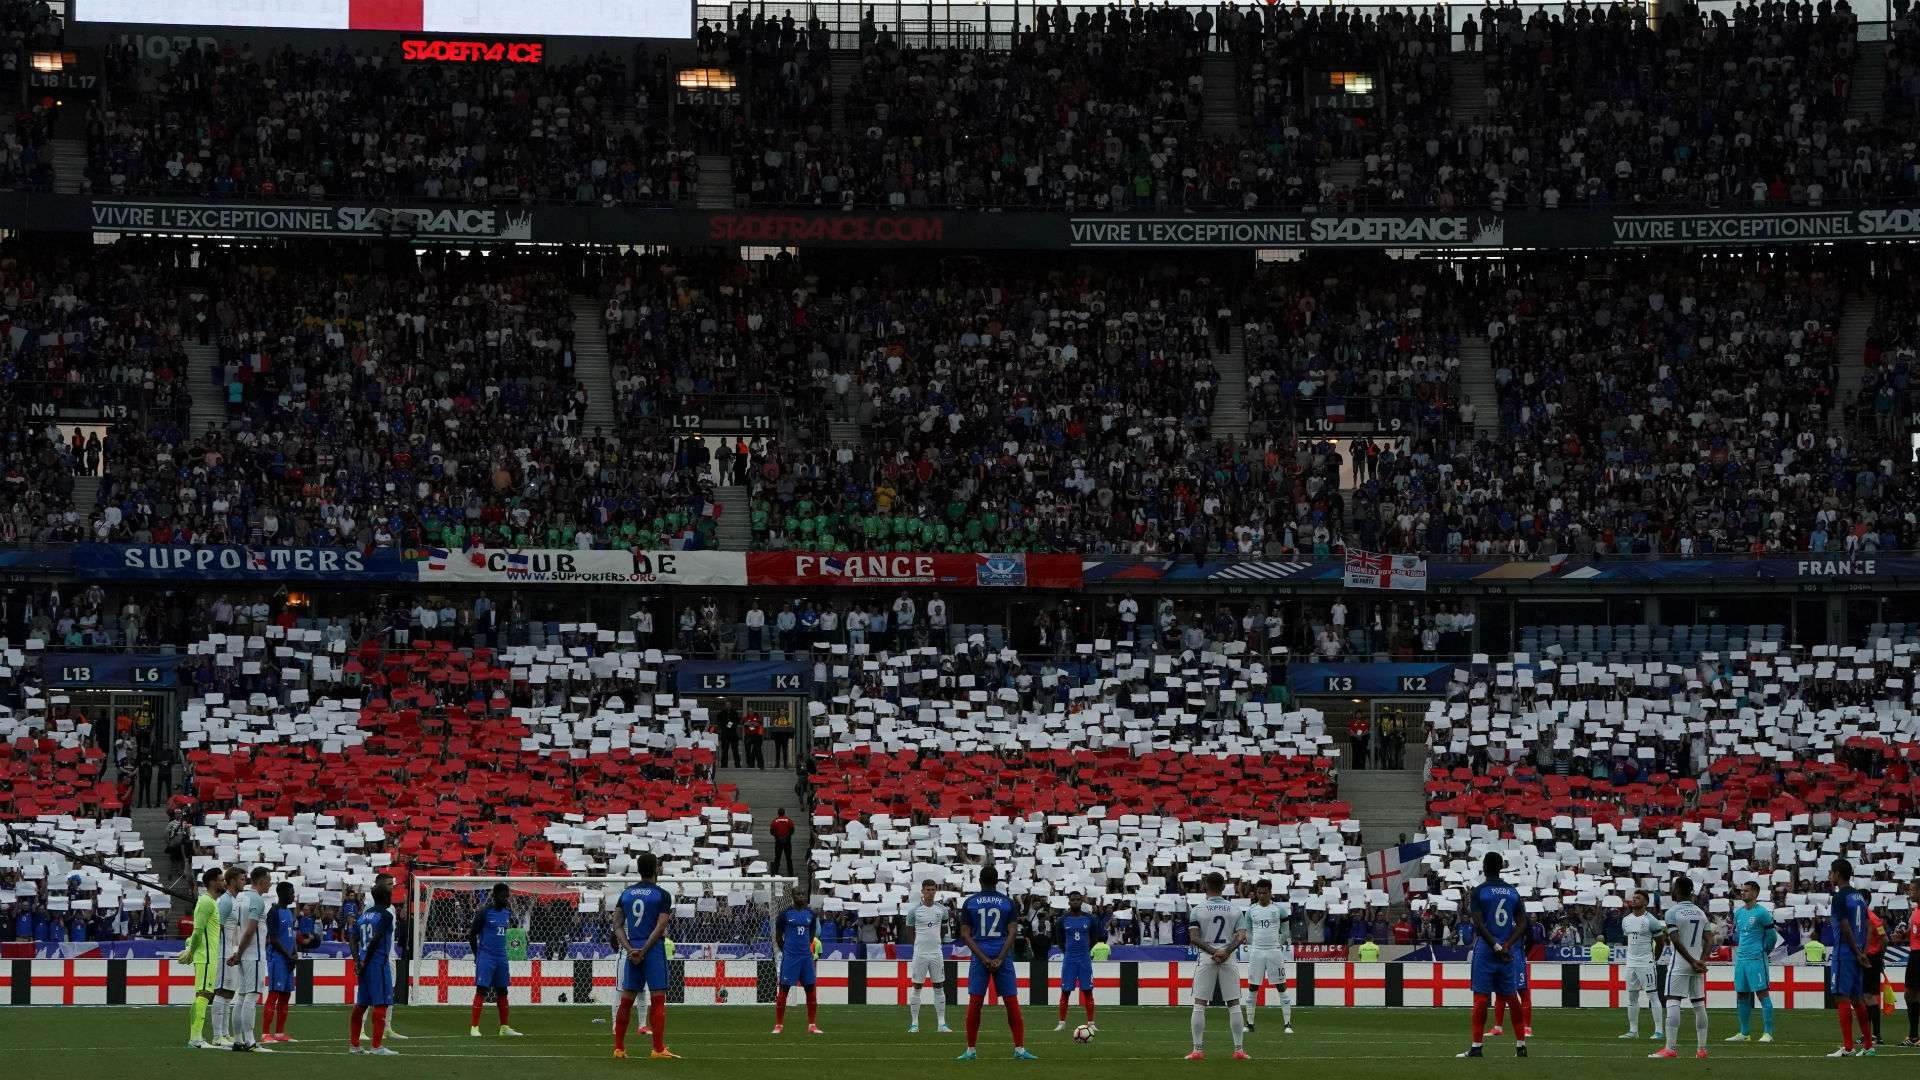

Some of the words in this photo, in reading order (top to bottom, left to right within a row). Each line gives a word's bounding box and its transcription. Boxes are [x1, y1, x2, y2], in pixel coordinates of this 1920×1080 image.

[67, 75, 97, 89] L17
[92, 206, 154, 225] VIVRE
[160, 209, 332, 231] L'EXCEPTIONNEL
[1070, 224, 1131, 241] VIVRE
[1138, 224, 1306, 242] L'EXCEPTIONNEL
[1310, 217, 1468, 241] STADEFRANCE
[1613, 221, 1674, 239] VIVRE
[1682, 216, 1852, 238] L'EXCEPTIONNEL
[31, 403, 57, 417] N4
[672, 414, 701, 428] L12
[743, 415, 770, 429] L11
[1377, 418, 1401, 431] L9
[124, 547, 365, 571] SUPPORTERS
[487, 552, 577, 573] CUB
[632, 554, 677, 575] DE
[1797, 560, 1876, 576] FRANCE
[507, 570, 657, 583] WWW.SUPPORTERS.ORG
[63, 667, 92, 681] L13
[135, 668, 160, 682] L6
[703, 674, 726, 689] L5
[776, 674, 801, 689] K4
[1328, 677, 1353, 691] K3
[1403, 677, 1428, 691] K2
[631, 898, 645, 928] 9
[1494, 898, 1509, 927] 6
[977, 907, 1002, 937] 12
[1212, 914, 1227, 944] 2
[1260, 919, 1271, 929] 10
[1074, 931, 1081, 941] 8
[1689, 919, 1701, 948] 7
[1297, 944, 1343, 953] FRANCE
